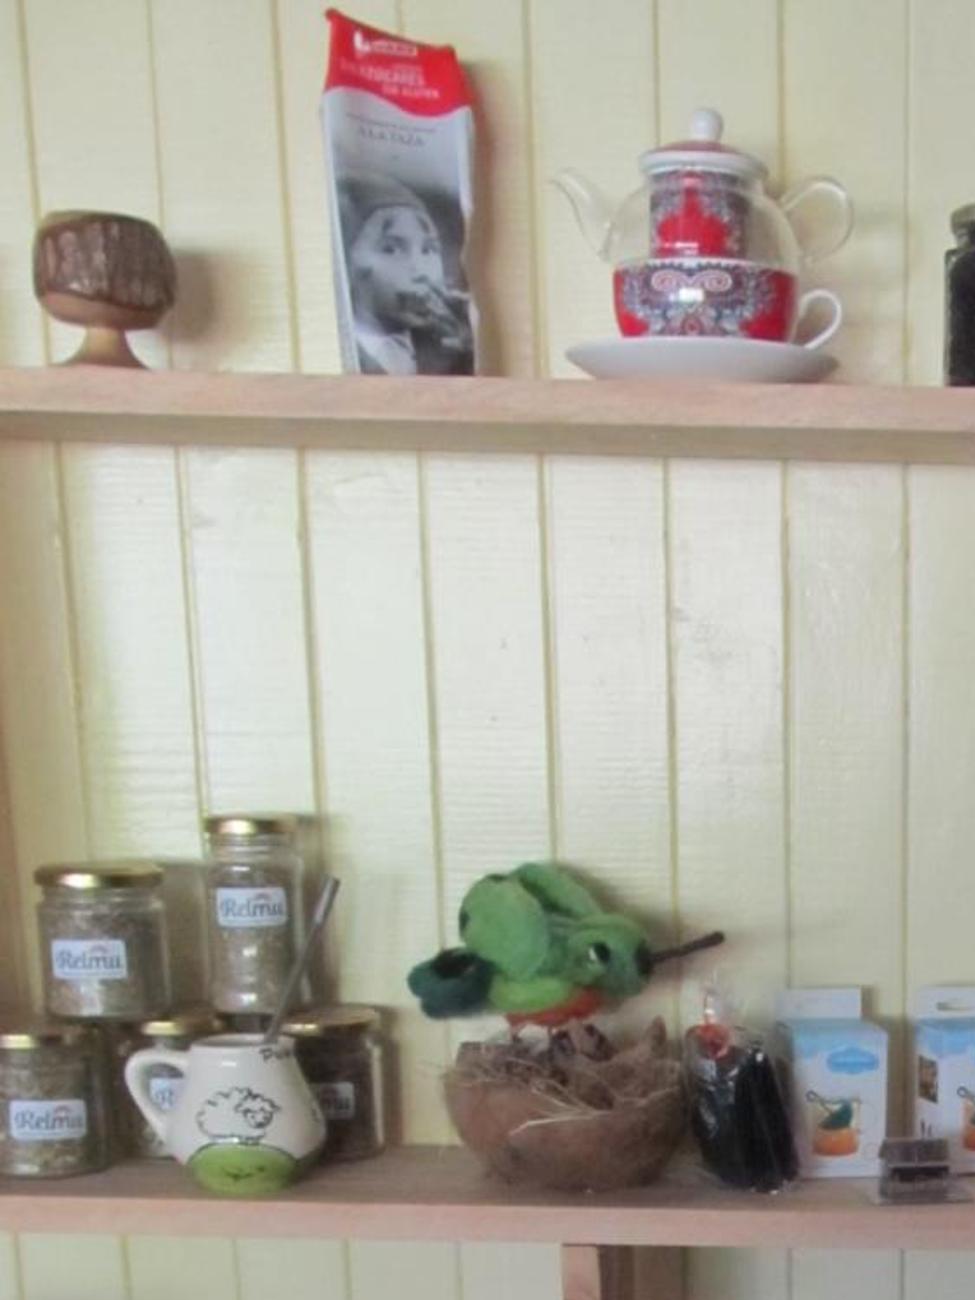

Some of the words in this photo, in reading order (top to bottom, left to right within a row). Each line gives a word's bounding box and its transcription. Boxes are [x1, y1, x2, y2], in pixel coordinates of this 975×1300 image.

[221, 895, 284, 918] Relmu
[55, 949, 123, 971] Relmu
[14, 1108, 85, 1130] Relmu
